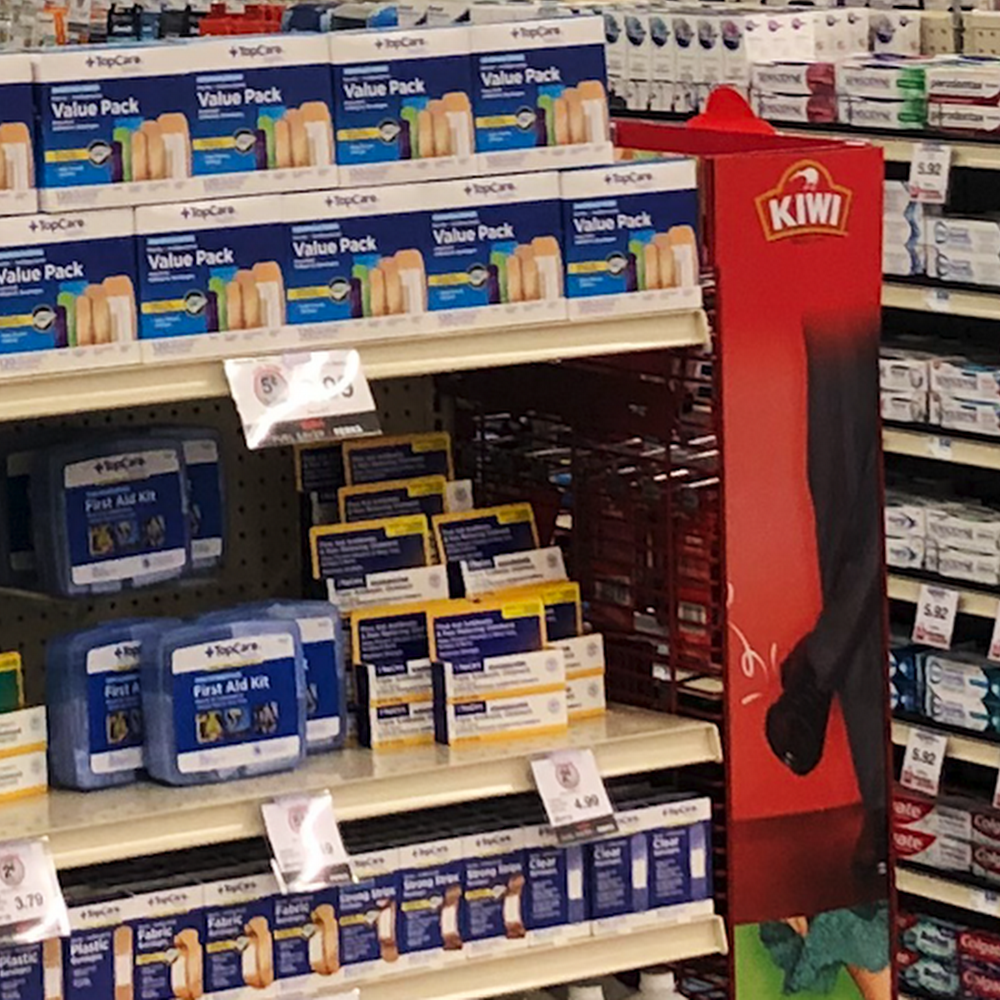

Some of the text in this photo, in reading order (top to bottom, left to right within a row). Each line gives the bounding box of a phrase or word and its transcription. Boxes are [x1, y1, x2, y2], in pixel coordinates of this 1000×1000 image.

[481, 66, 562, 87] Value Pack
[197, 87, 283, 107] Value Pack
[344, 78, 426, 99] Value Pack
[51, 97, 140, 119] Value Pack
[917, 162, 942, 176] 5.92
[768, 194, 842, 231] KIWI
[573, 211, 652, 233] Value Pack
[433, 223, 514, 244] Value Pack
[293, 235, 378, 257] Value Pack
[147, 248, 234, 270] Value Pack
[44, 261, 84, 280] Pack
[85, 490, 158, 514] First Aid Kit
[924, 604, 949, 620] 5.92
[215, 642, 259, 657] TopCare
[105, 683, 131, 699] First
[193, 675, 271, 699] First Aid Kit
[912, 748, 936, 766] 5.92
[653, 836, 679, 849] Clear
[529, 856, 556, 870] Clear
[594, 847, 621, 861] Clear
[275, 901, 310, 917] Fabric
[207, 914, 243, 929] Fabric
[138, 926, 173, 941] Fabric
[70, 938, 110, 955] Plastic
[0, 951, 39, 968] Plastic
